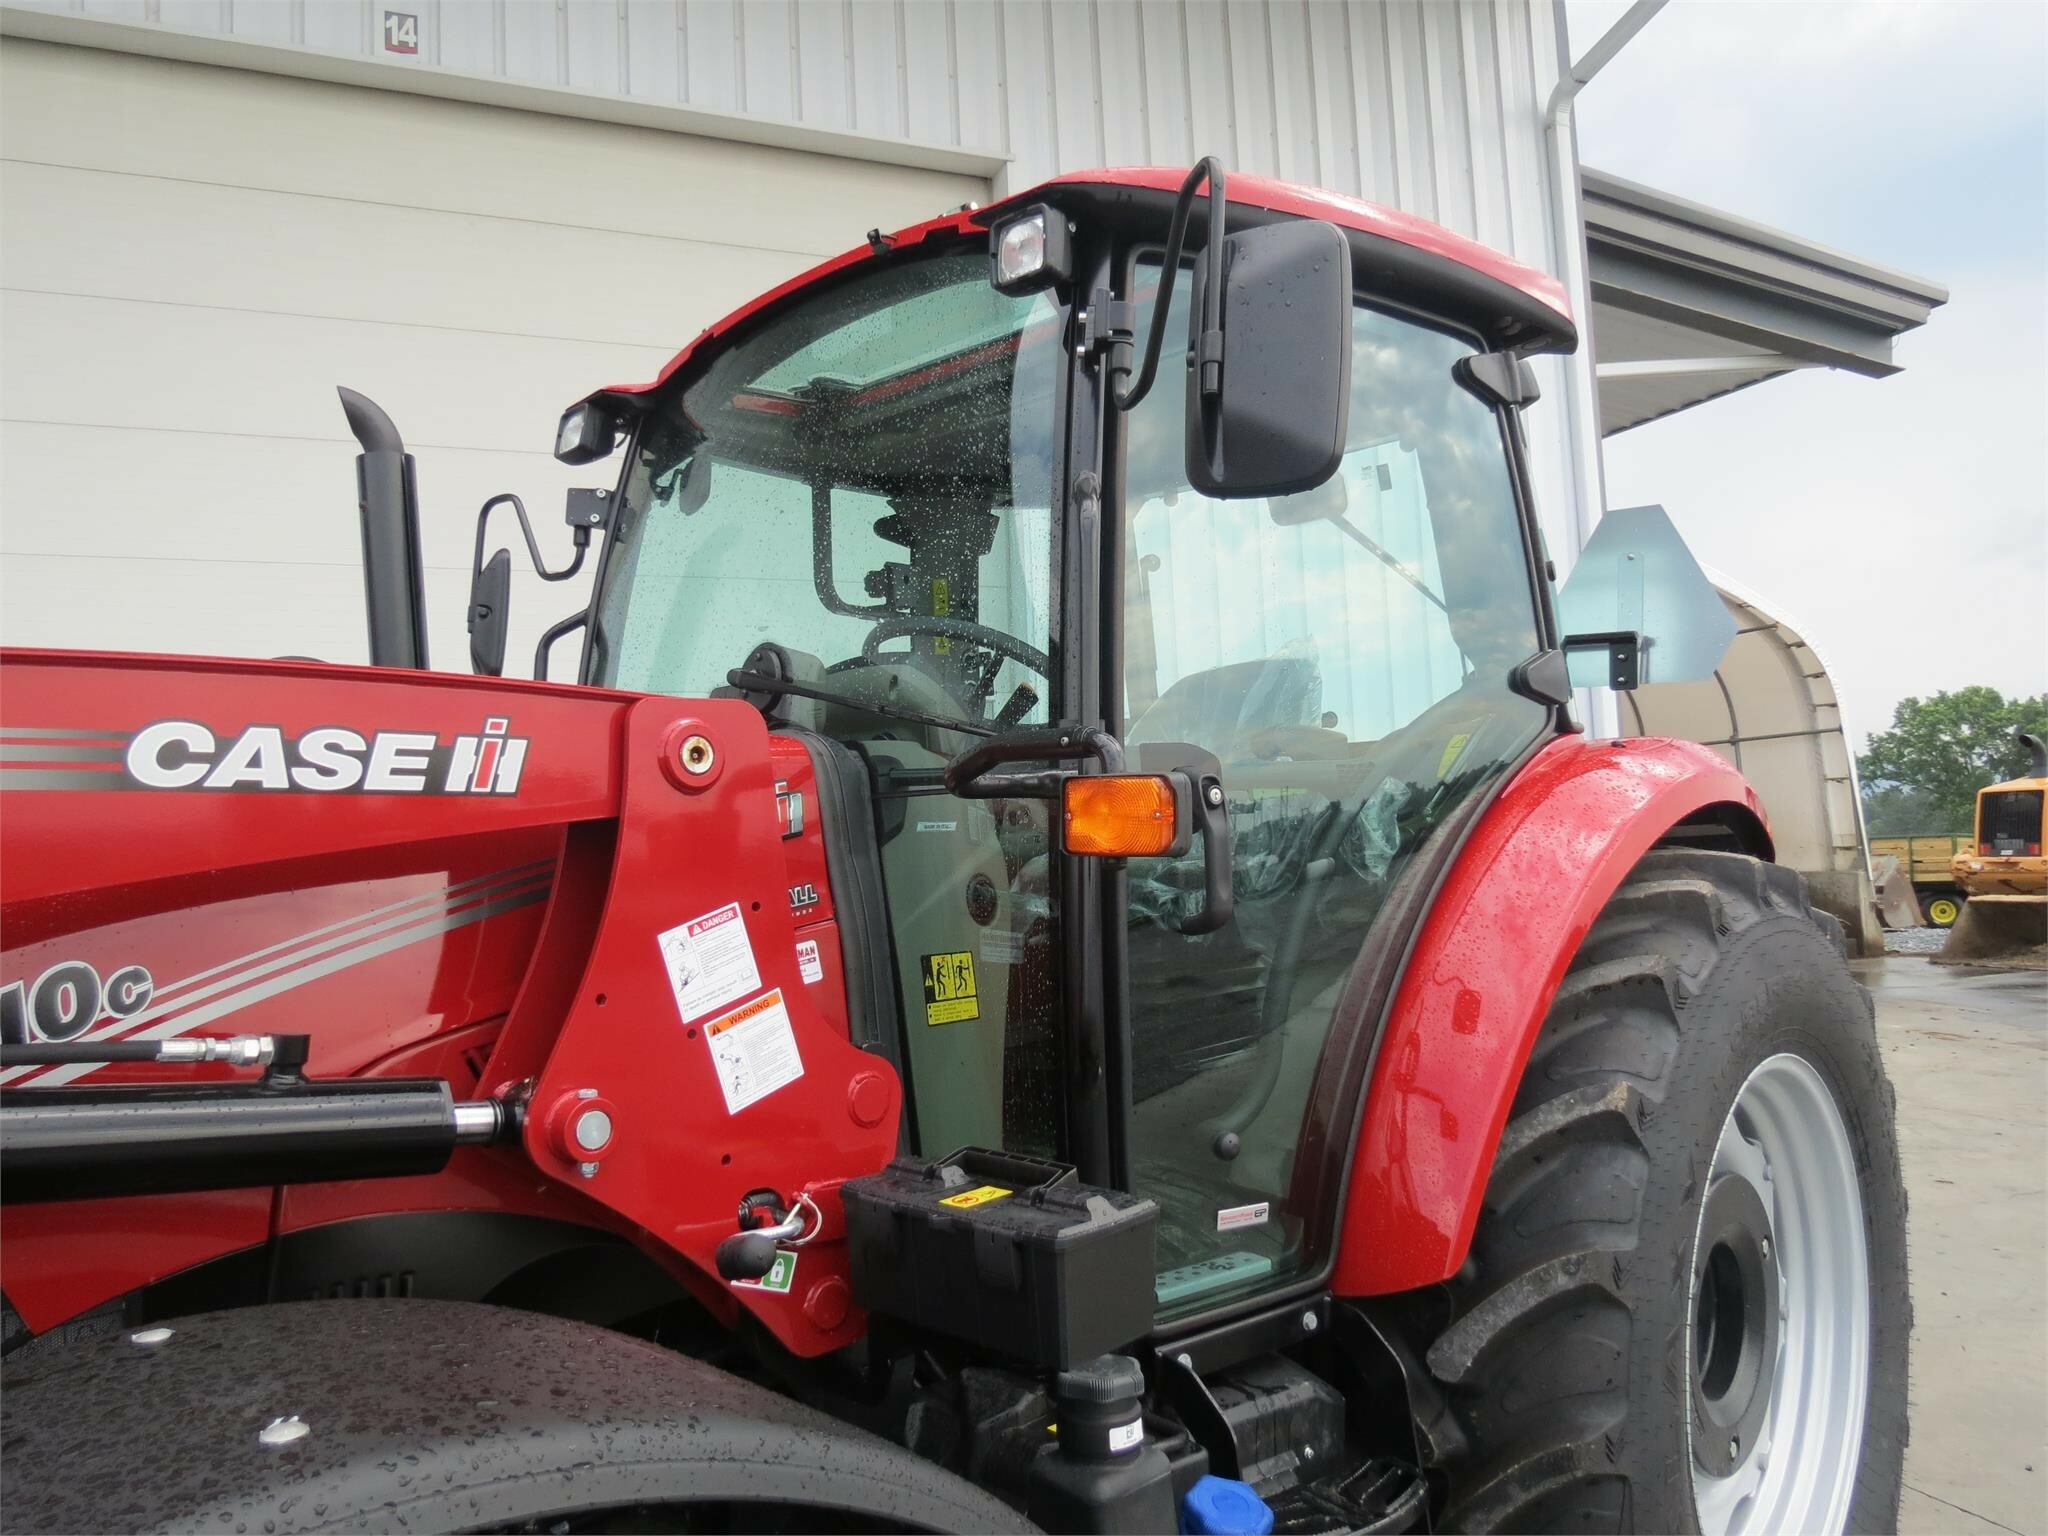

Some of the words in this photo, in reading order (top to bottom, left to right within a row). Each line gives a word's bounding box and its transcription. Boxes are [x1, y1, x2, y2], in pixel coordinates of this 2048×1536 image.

[385, 15, 417, 48] 14
[126, 720, 438, 793] CASE
[701, 909, 735, 931] DANGER
[728, 999, 770, 1025] WARNING
